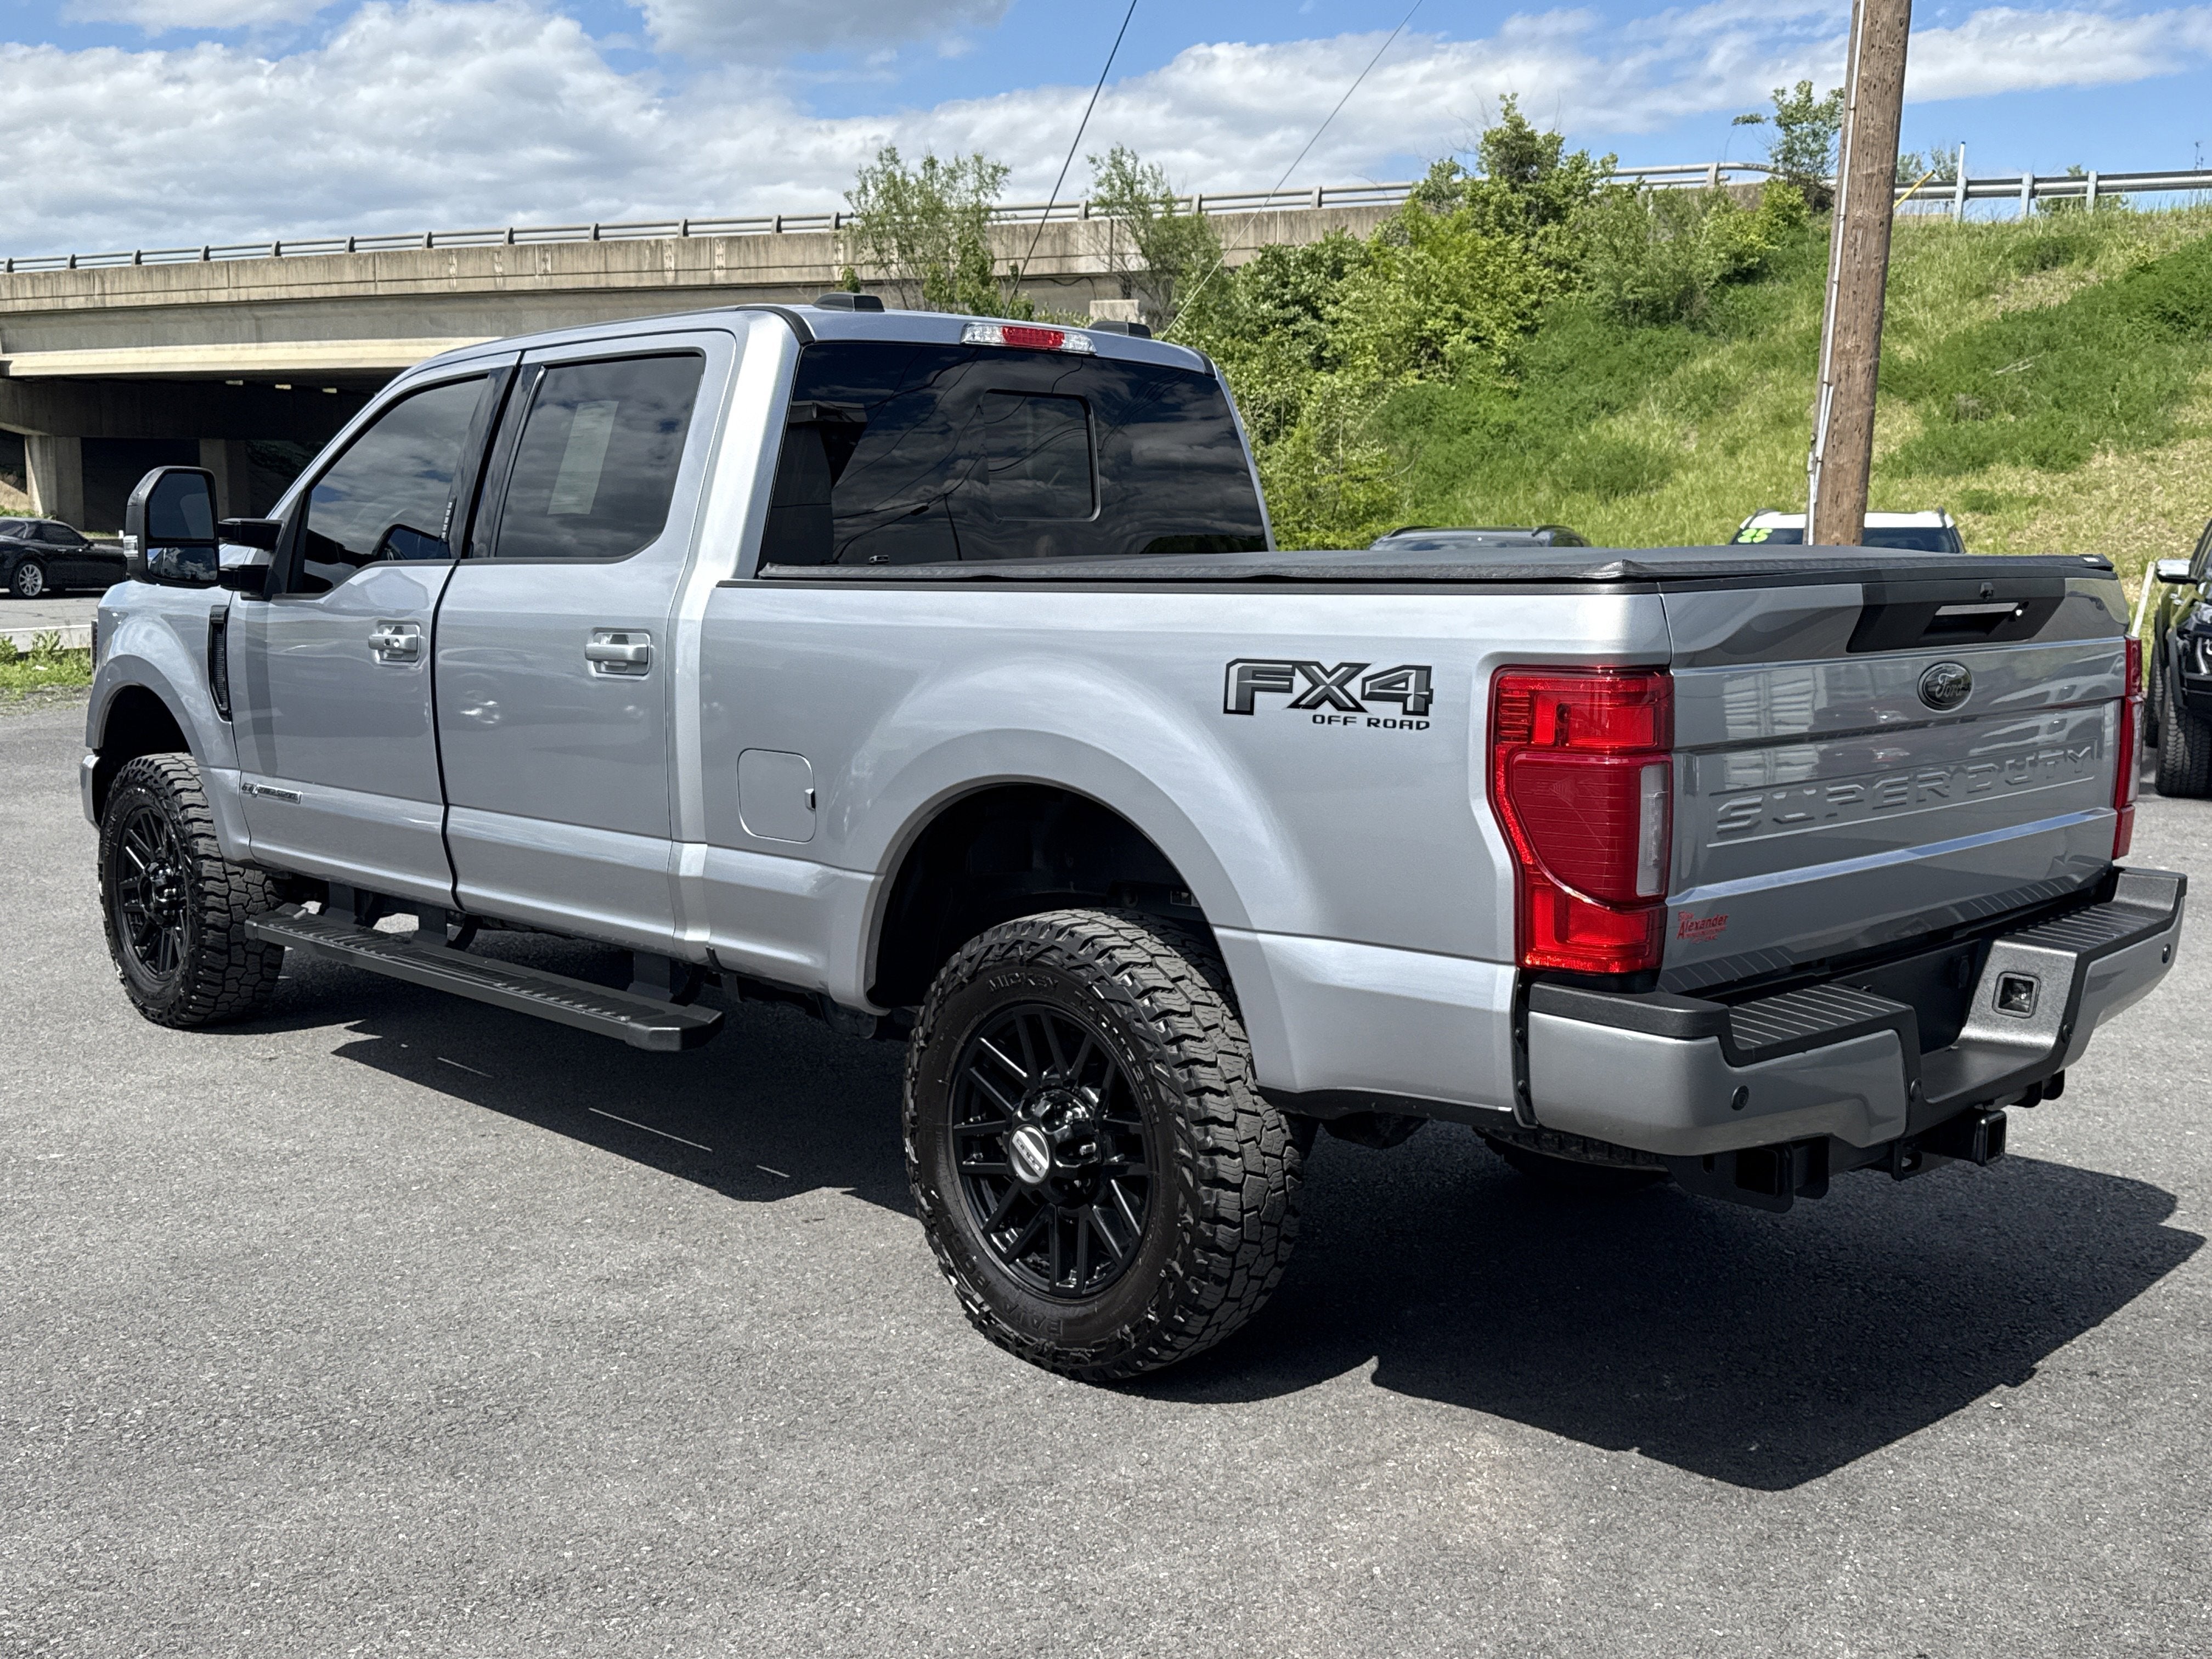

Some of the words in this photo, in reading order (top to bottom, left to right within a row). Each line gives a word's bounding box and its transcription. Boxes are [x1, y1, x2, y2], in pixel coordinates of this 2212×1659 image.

[1737, 528, 1773, 543] 25
[1223, 658, 1434, 716] FX4
[1935, 673, 1964, 699] Ford
[1312, 714, 1357, 726] OFF
[1367, 718, 1430, 730] ROAD
[1677, 913, 1729, 940] Alexander
